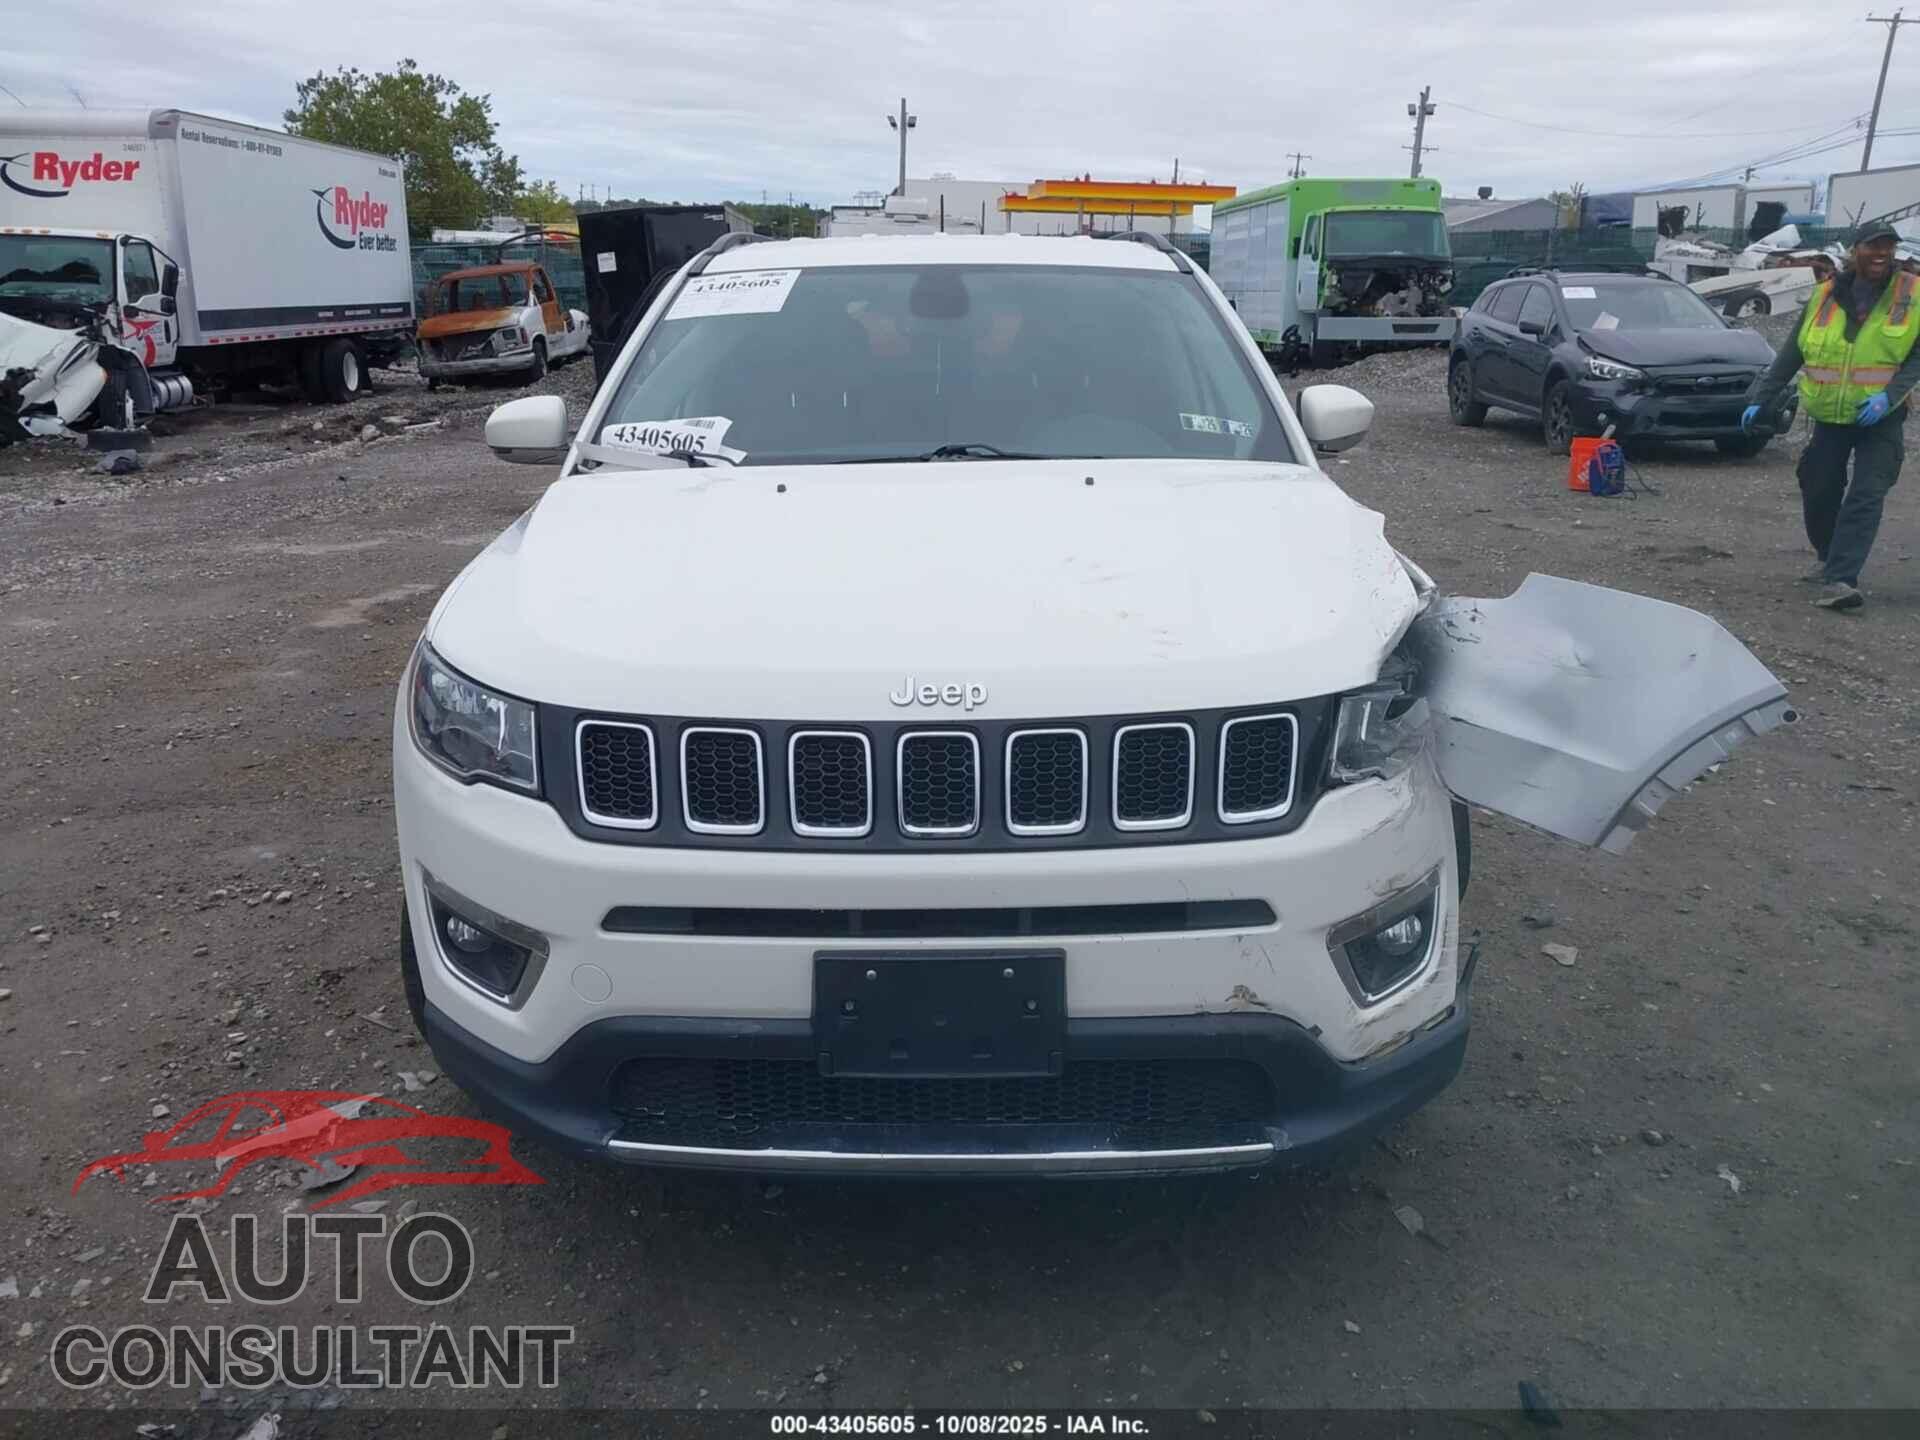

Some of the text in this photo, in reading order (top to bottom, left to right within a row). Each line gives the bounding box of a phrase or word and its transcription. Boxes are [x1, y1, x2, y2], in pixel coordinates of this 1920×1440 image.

[33, 151, 140, 188] Ryder
[335, 186, 388, 236] Ryder
[359, 231, 375, 250] Ever
[692, 278, 783, 294] 43405605
[614, 426, 707, 452] 43405605
[889, 676, 989, 712] Jeep
